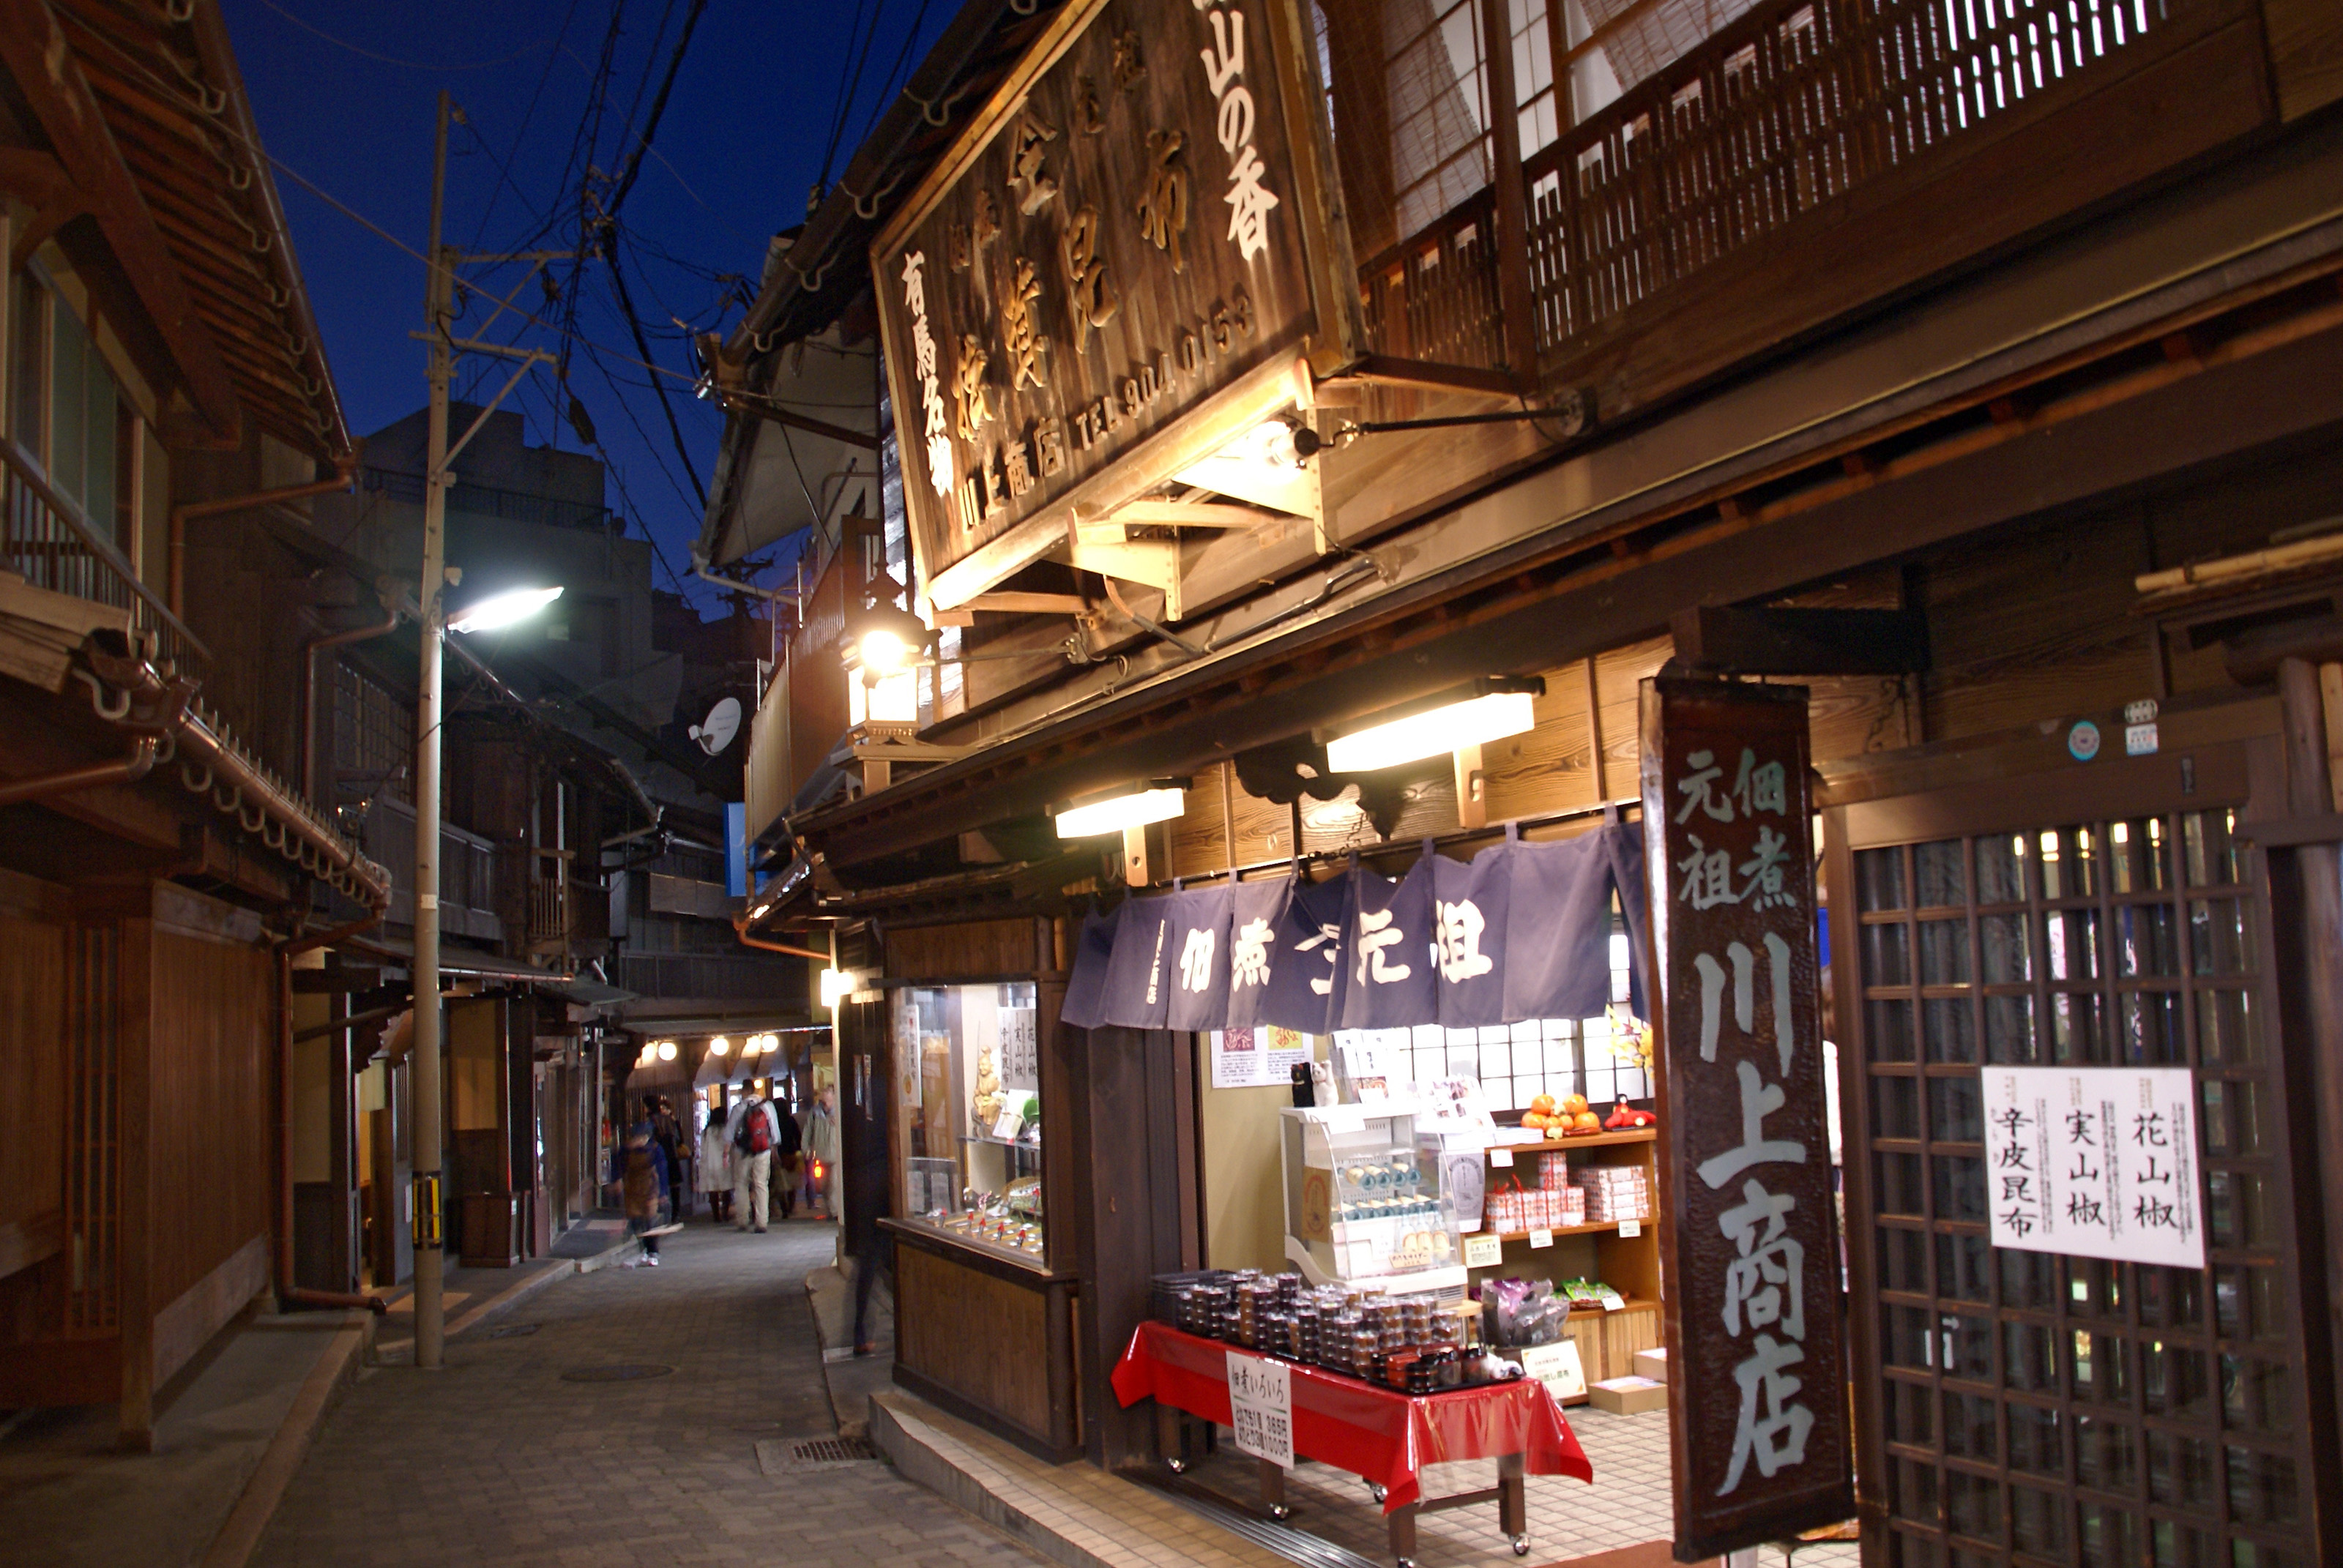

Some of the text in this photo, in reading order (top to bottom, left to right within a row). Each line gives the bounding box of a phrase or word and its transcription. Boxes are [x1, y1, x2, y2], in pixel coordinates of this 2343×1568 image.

[1192, 0, 1279, 261] 山の香
[902, 250, 953, 497] 有馬名物
[958, 417, 1066, 534] 川上商店
[1076, 396, 1122, 451] TEL
[1124, 352, 1175, 419] 904
[1675, 748, 1738, 911] 元祖
[1732, 746, 1798, 913] 佃煮
[1695, 932, 1816, 1498] 川上商店
[1995, 1108, 2038, 1239] 辛皮昆布
[2066, 1110, 2106, 1226] 実山椒
[2133, 1112, 2178, 1229] 花山椒
